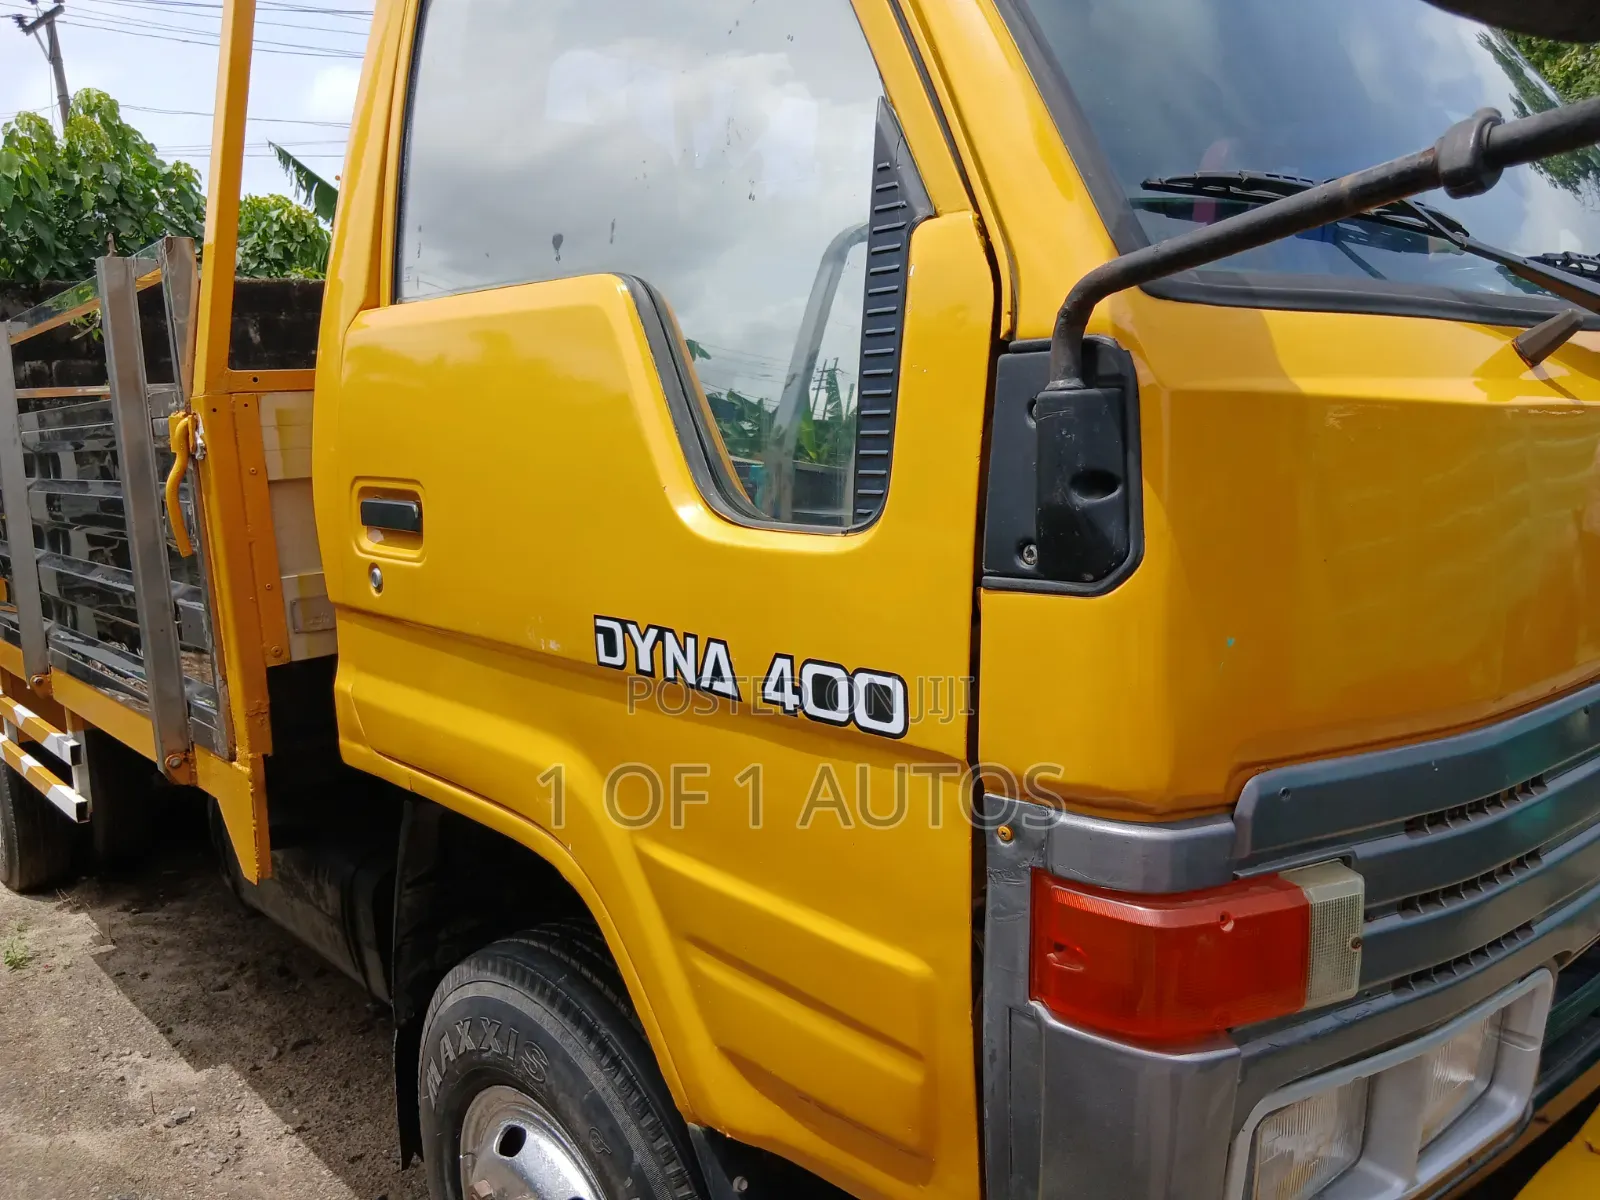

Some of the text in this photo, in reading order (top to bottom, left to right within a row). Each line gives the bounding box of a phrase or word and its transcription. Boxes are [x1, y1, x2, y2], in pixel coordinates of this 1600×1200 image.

[594, 614, 909, 739] DYNA 400
[426, 1016, 550, 1110] MAXXIS
